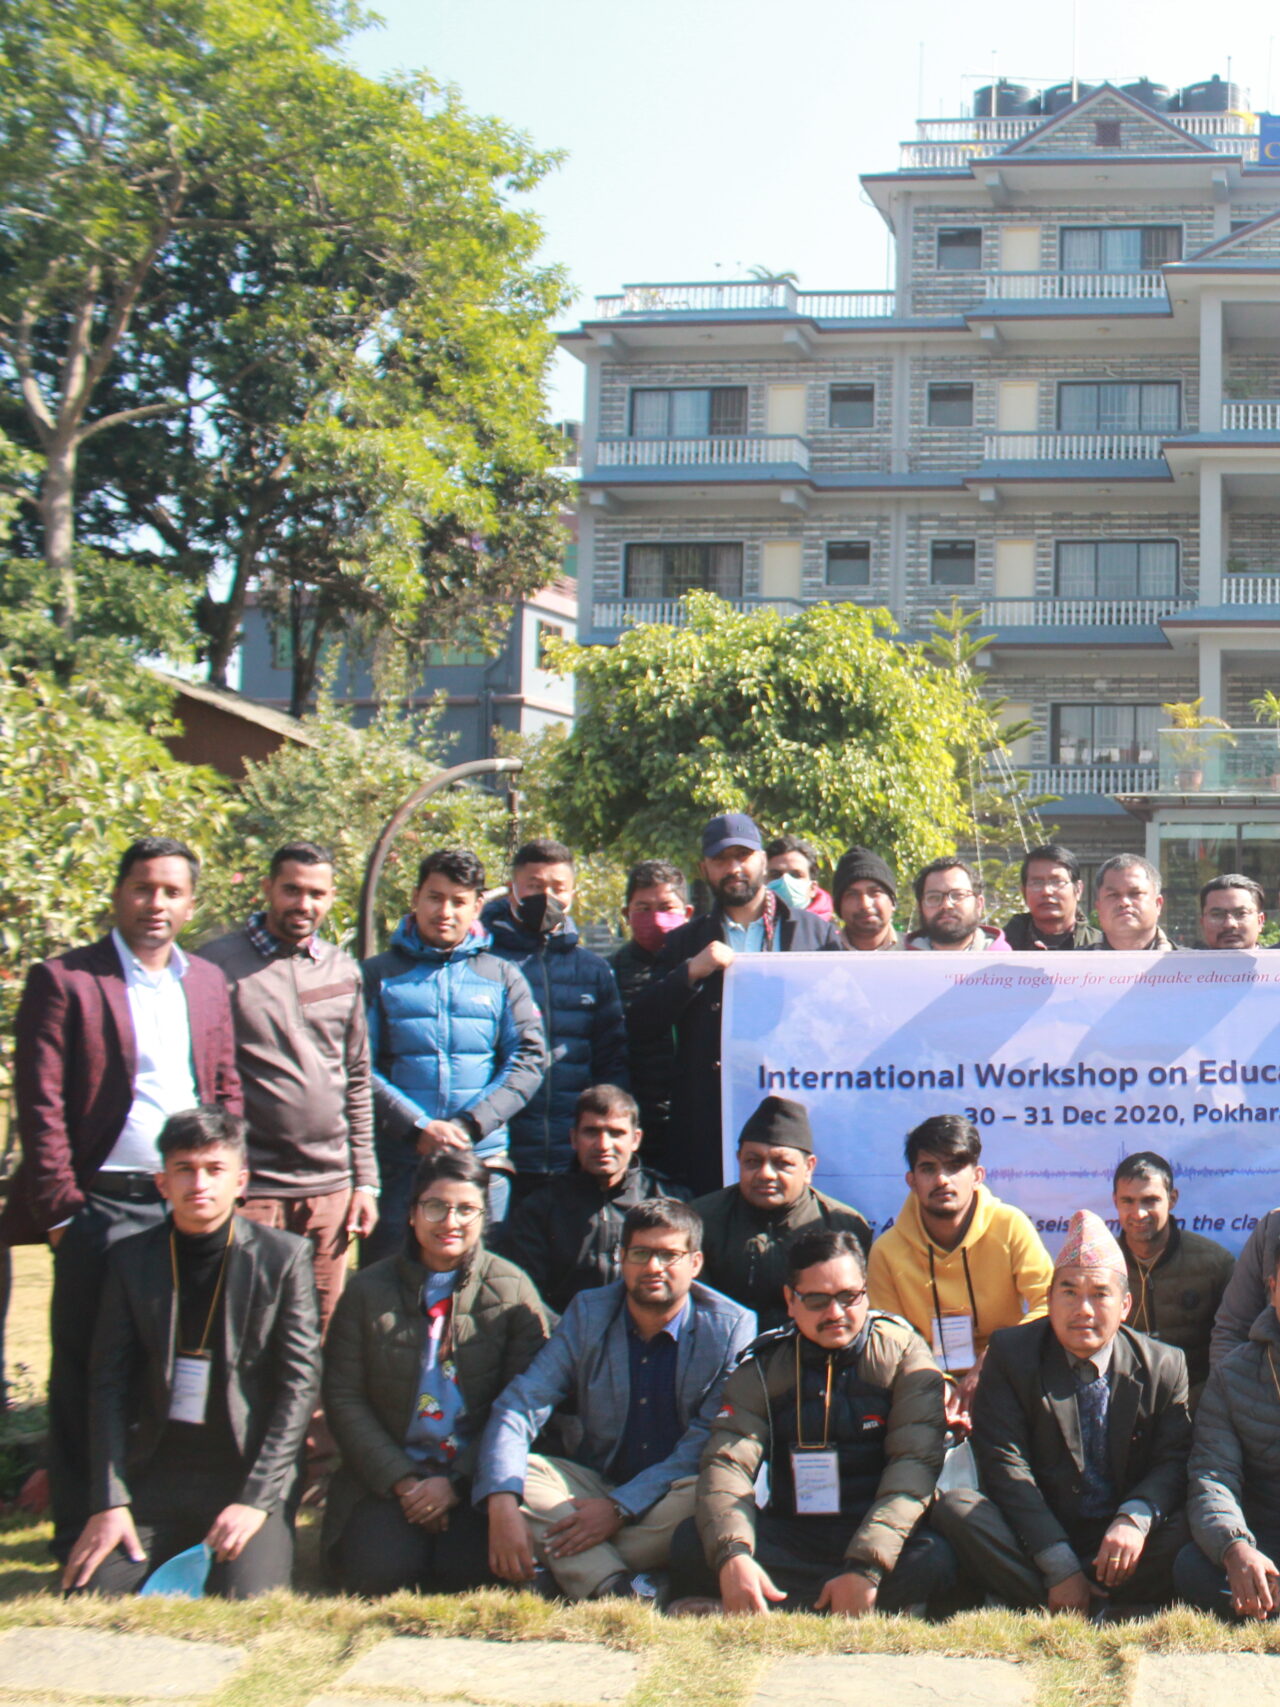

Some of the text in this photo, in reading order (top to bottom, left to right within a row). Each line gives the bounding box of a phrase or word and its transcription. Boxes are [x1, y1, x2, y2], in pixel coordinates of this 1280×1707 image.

[1018, 973, 1079, 988] together
[1080, 971, 1105, 988] for
[1108, 971, 1193, 987] earthquake
[1196, 969, 1269, 984] education
[758, 1063, 964, 1089] International
[975, 1062, 1138, 1092] Workshop
[1148, 1065, 1188, 1086] on
[964, 1106, 995, 1125] 30
[1024, 1105, 1054, 1125] 31
[1063, 1105, 1107, 1125] Dec
[1113, 1103, 1185, 1126] 2020,
[1193, 1213, 1226, 1231] the
